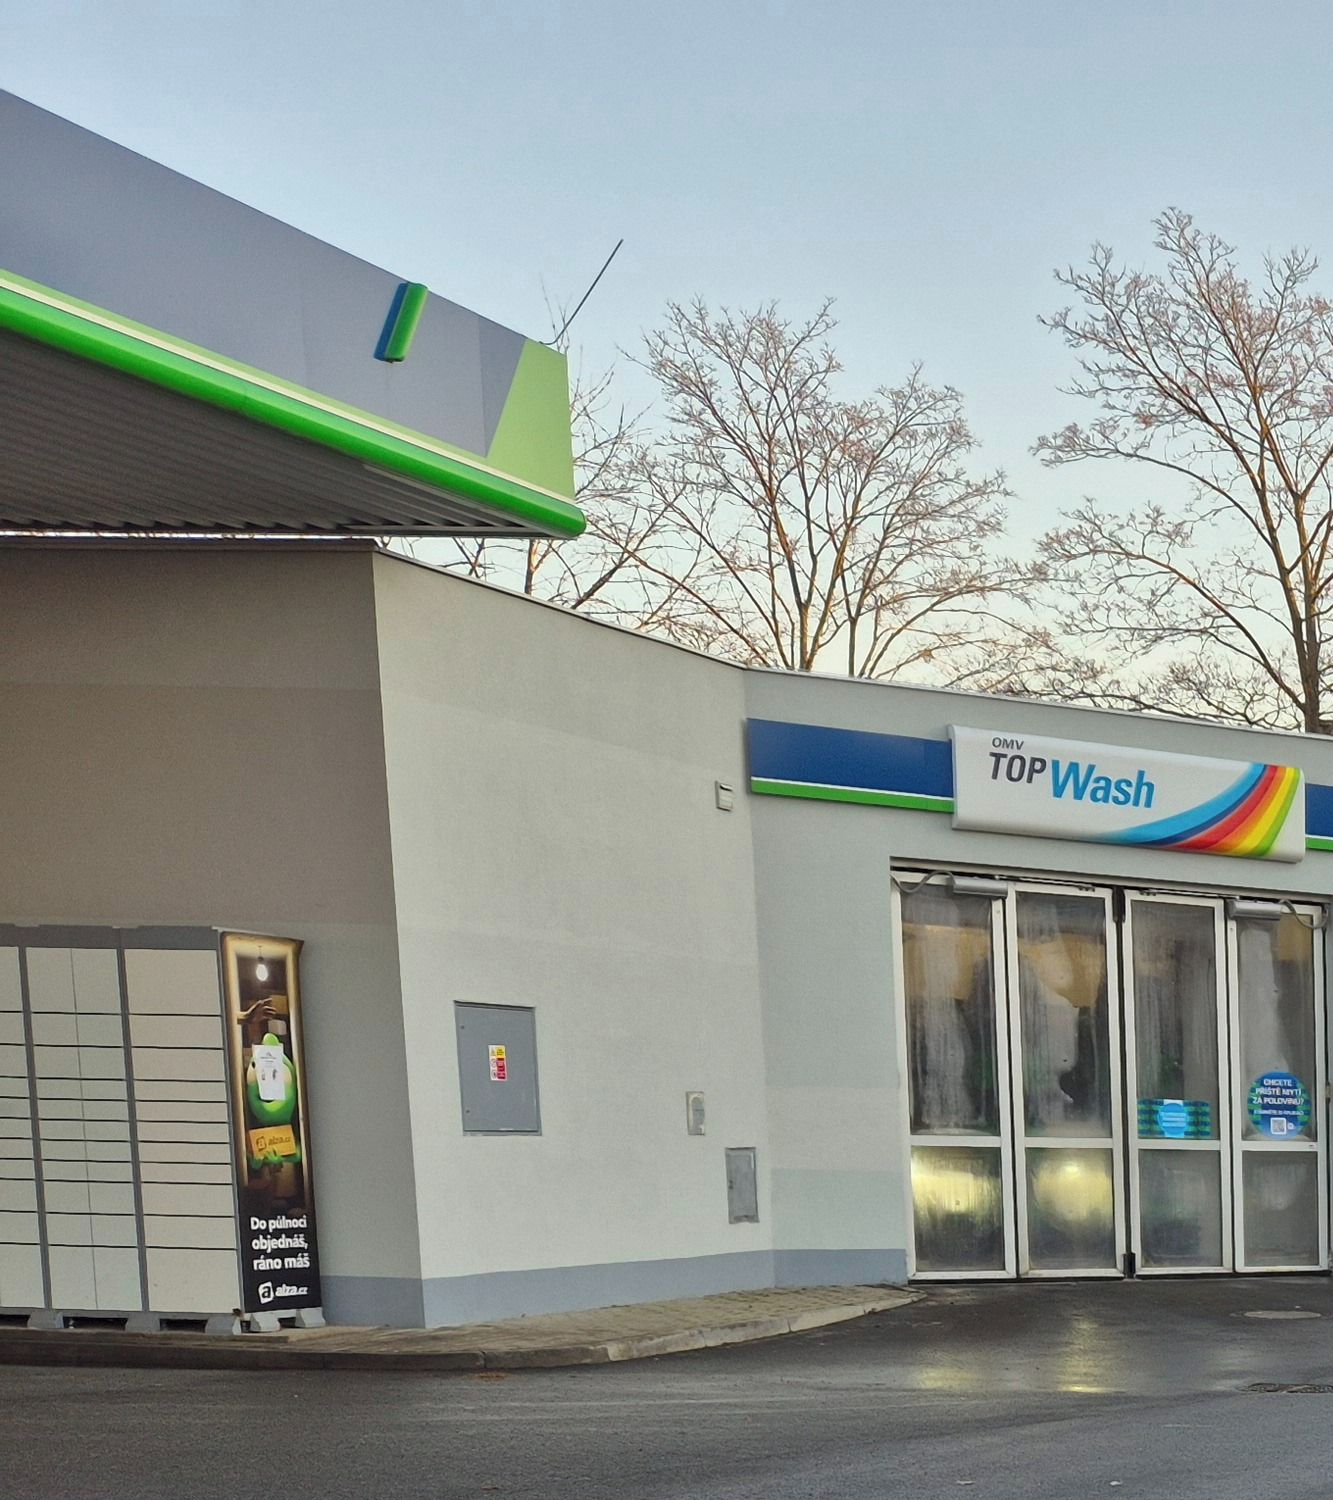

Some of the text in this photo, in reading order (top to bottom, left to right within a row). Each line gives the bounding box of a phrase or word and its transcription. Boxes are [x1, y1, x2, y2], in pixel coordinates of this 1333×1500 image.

[992, 737, 1024, 750] OMV
[989, 752, 1155, 808] TOP Wash
[250, 1214, 307, 1233] Do půlnoci
[251, 1233, 309, 1253] objednáš,
[253, 1252, 310, 1271] ráno máš
[275, 1283, 308, 1297] alza.cz
